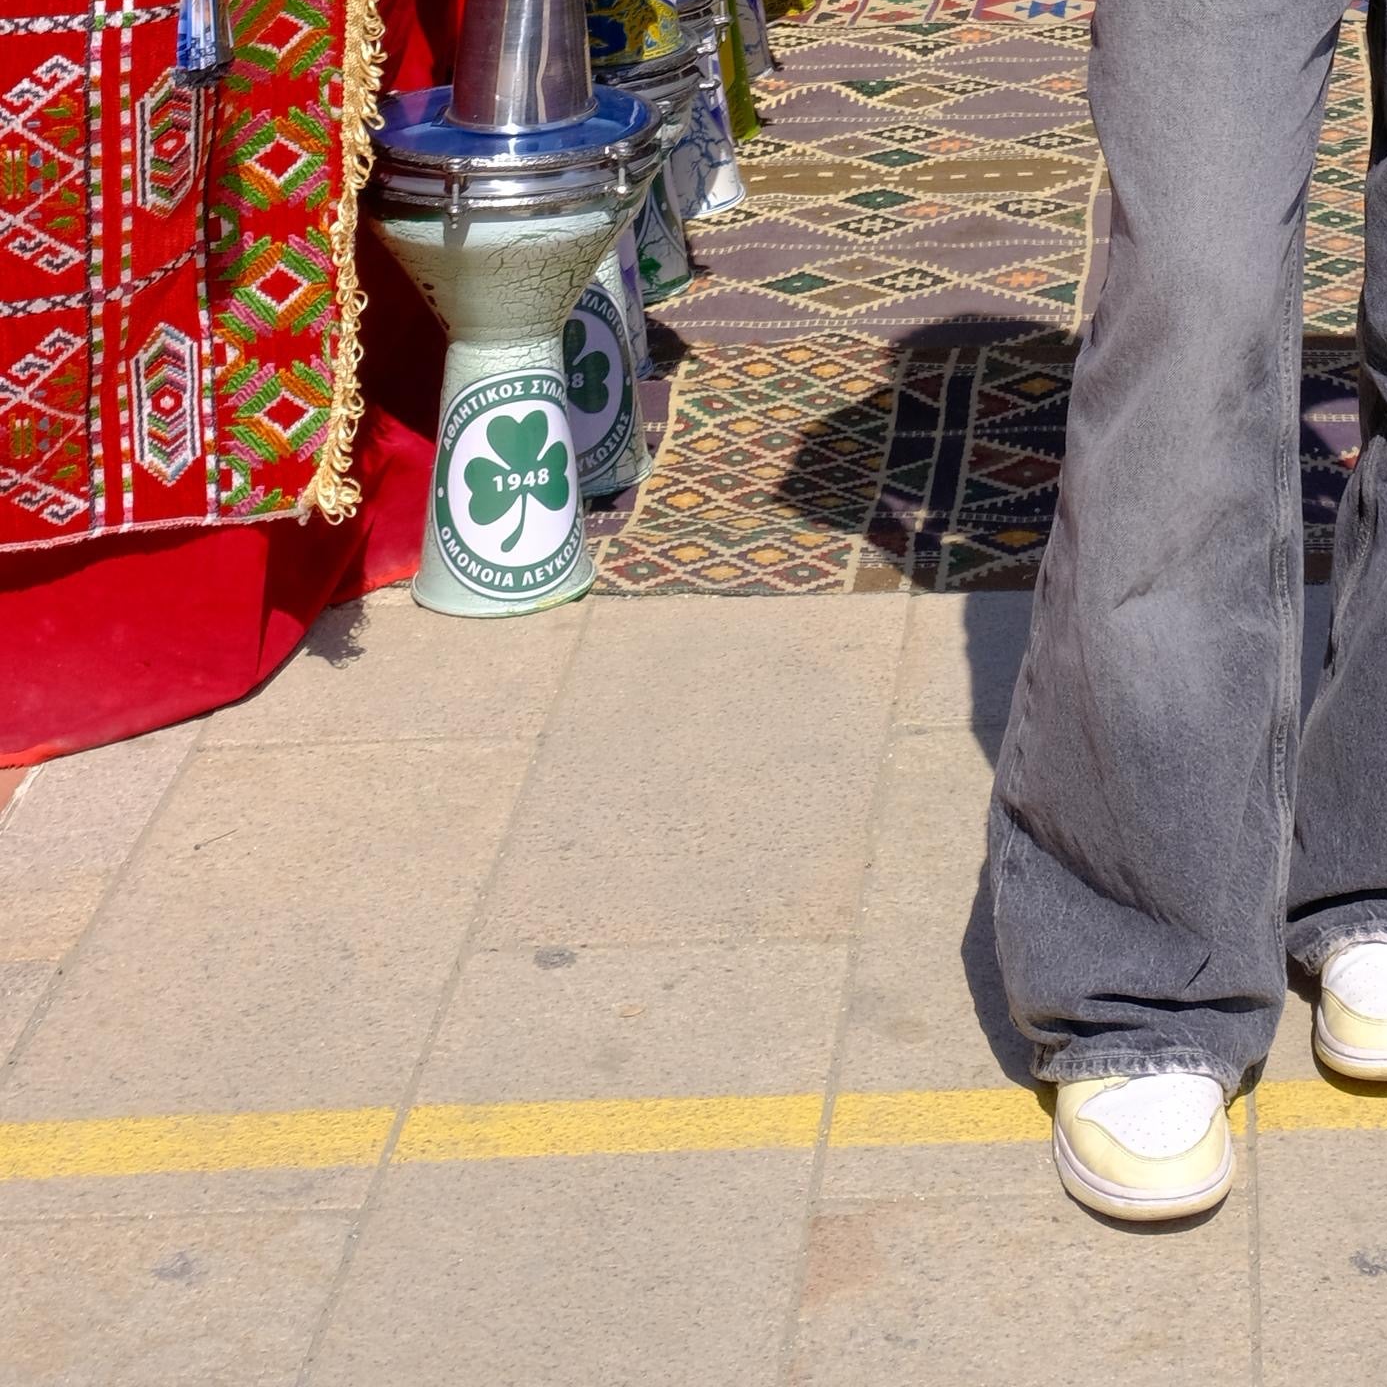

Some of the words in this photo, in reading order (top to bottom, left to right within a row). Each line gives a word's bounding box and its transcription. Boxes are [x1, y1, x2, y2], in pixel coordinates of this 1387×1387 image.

[581, 289, 627, 346] ΥΛΛΟΓΟΣ
[443, 380, 525, 451] ΑΘΛΗΤΙΚΟΣ
[577, 410, 631, 475] ΥΚΩΣΙΑΣ
[492, 468, 550, 492] 1948
[441, 526, 513, 588] ΟΜΟΝΟΙΑ
